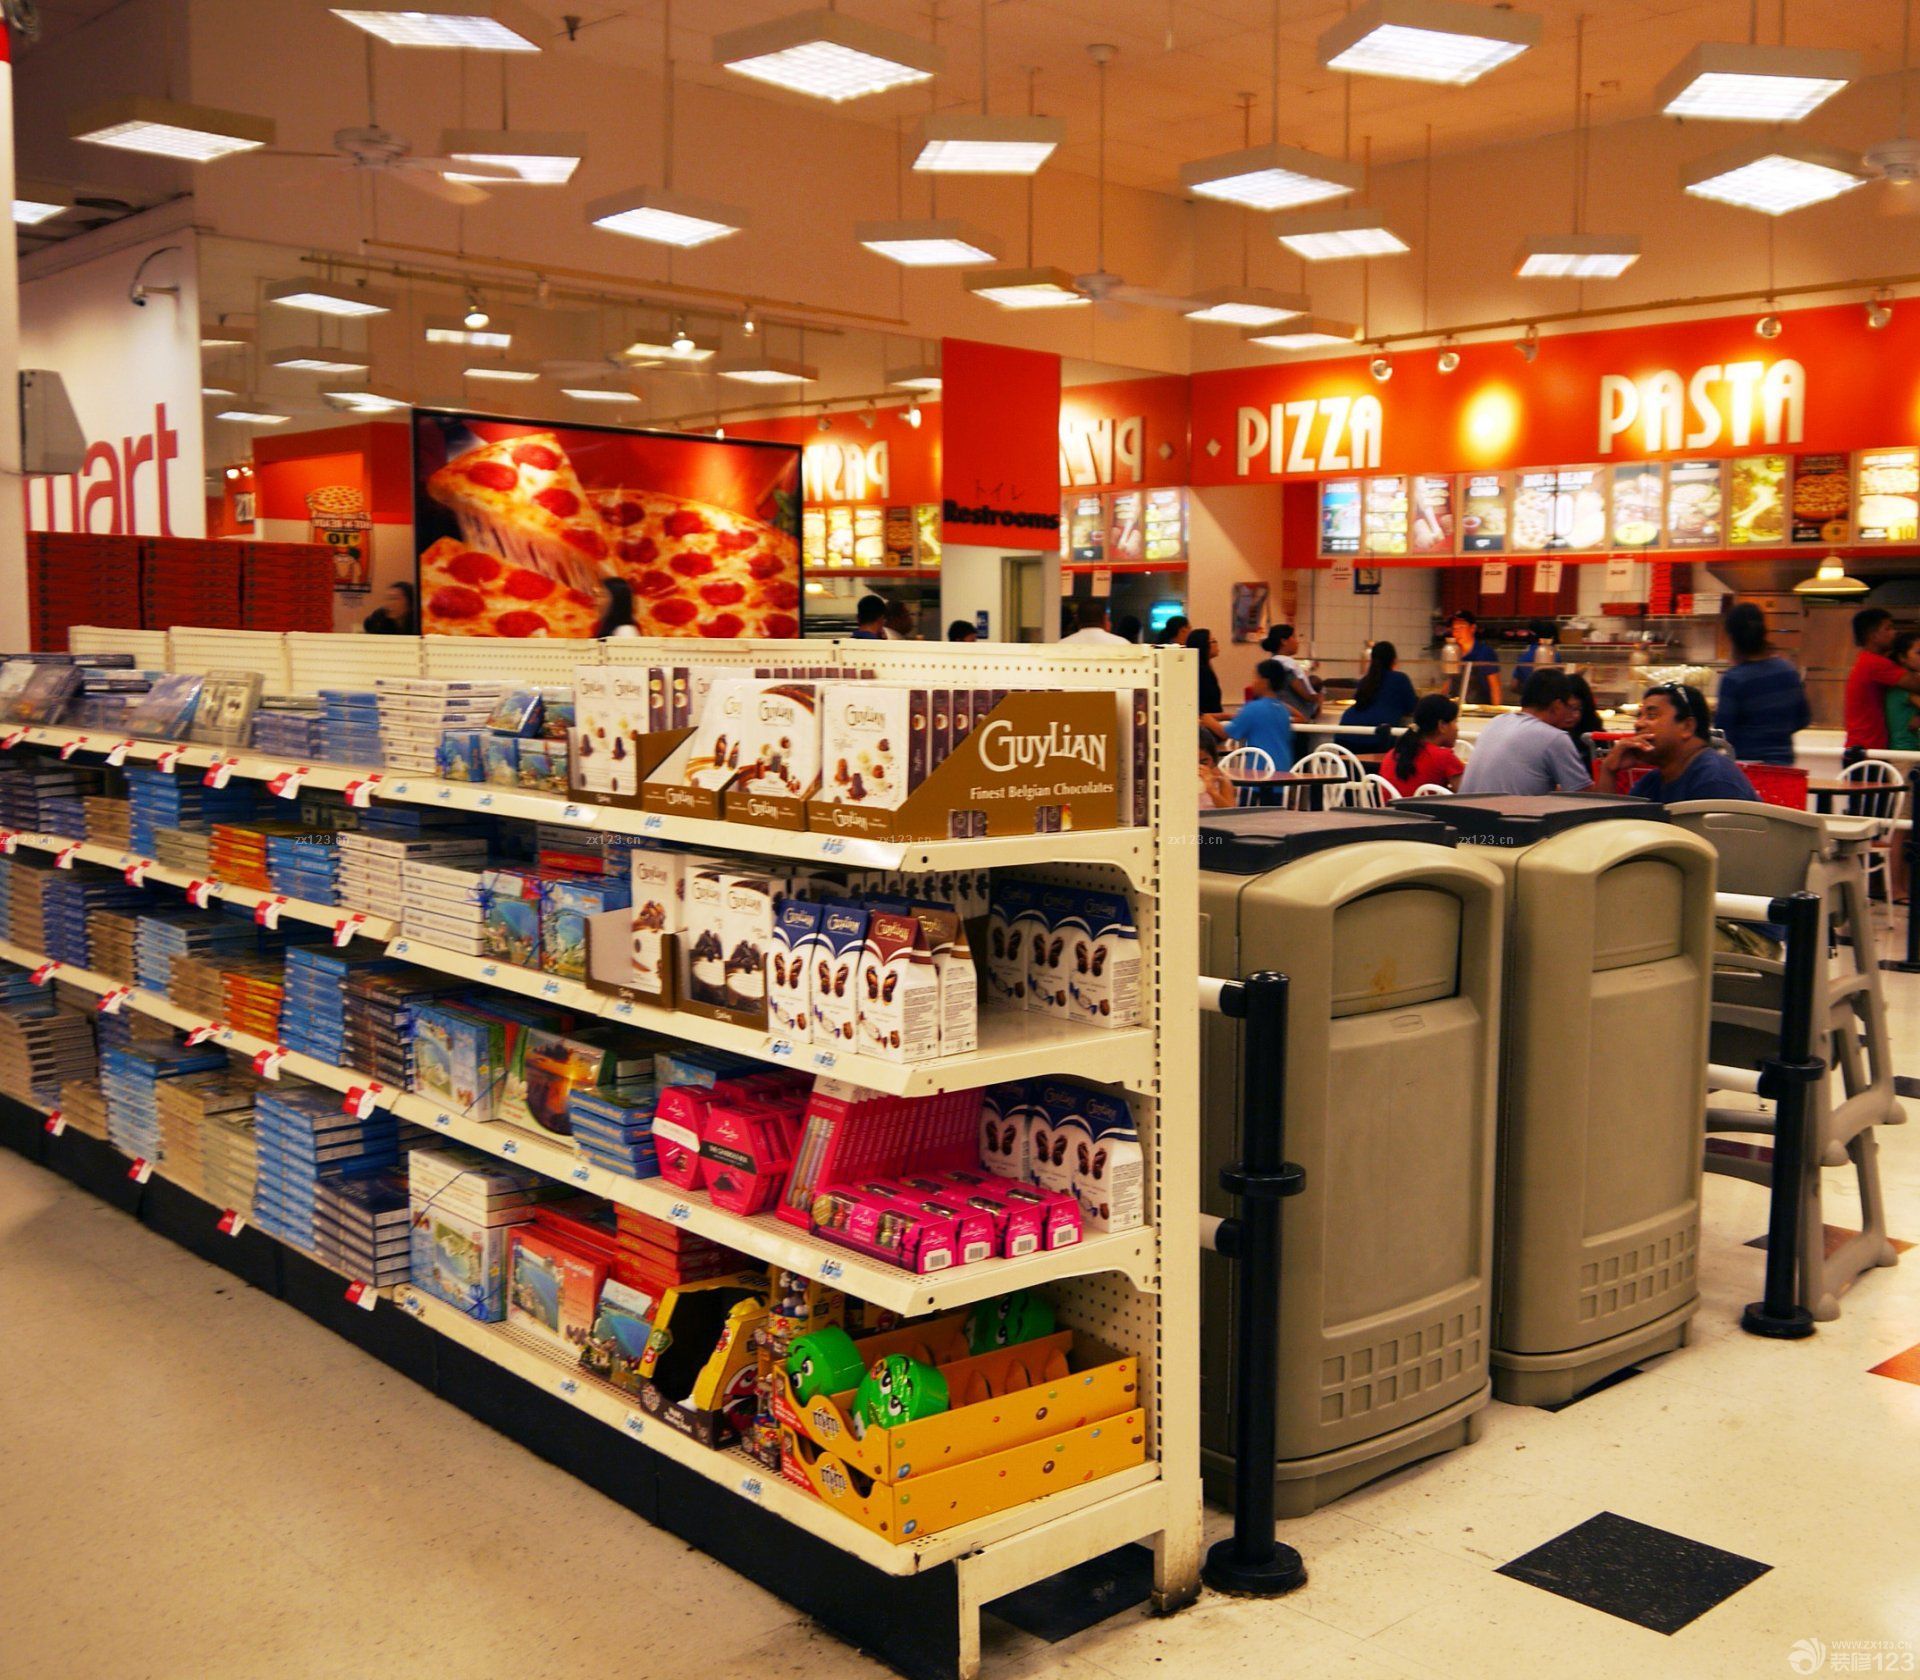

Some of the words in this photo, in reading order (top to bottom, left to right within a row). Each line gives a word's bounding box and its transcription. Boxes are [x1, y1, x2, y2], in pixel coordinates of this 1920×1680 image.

[1599, 359, 1806, 454] PASTA
[1237, 394, 1384, 476] PIZZA
[943, 499, 1060, 530] Restrooms
[970, 787, 1006, 800] Finest
[1008, 785, 1051, 801] Belgian
[1053, 782, 1114, 797] Chocolates
